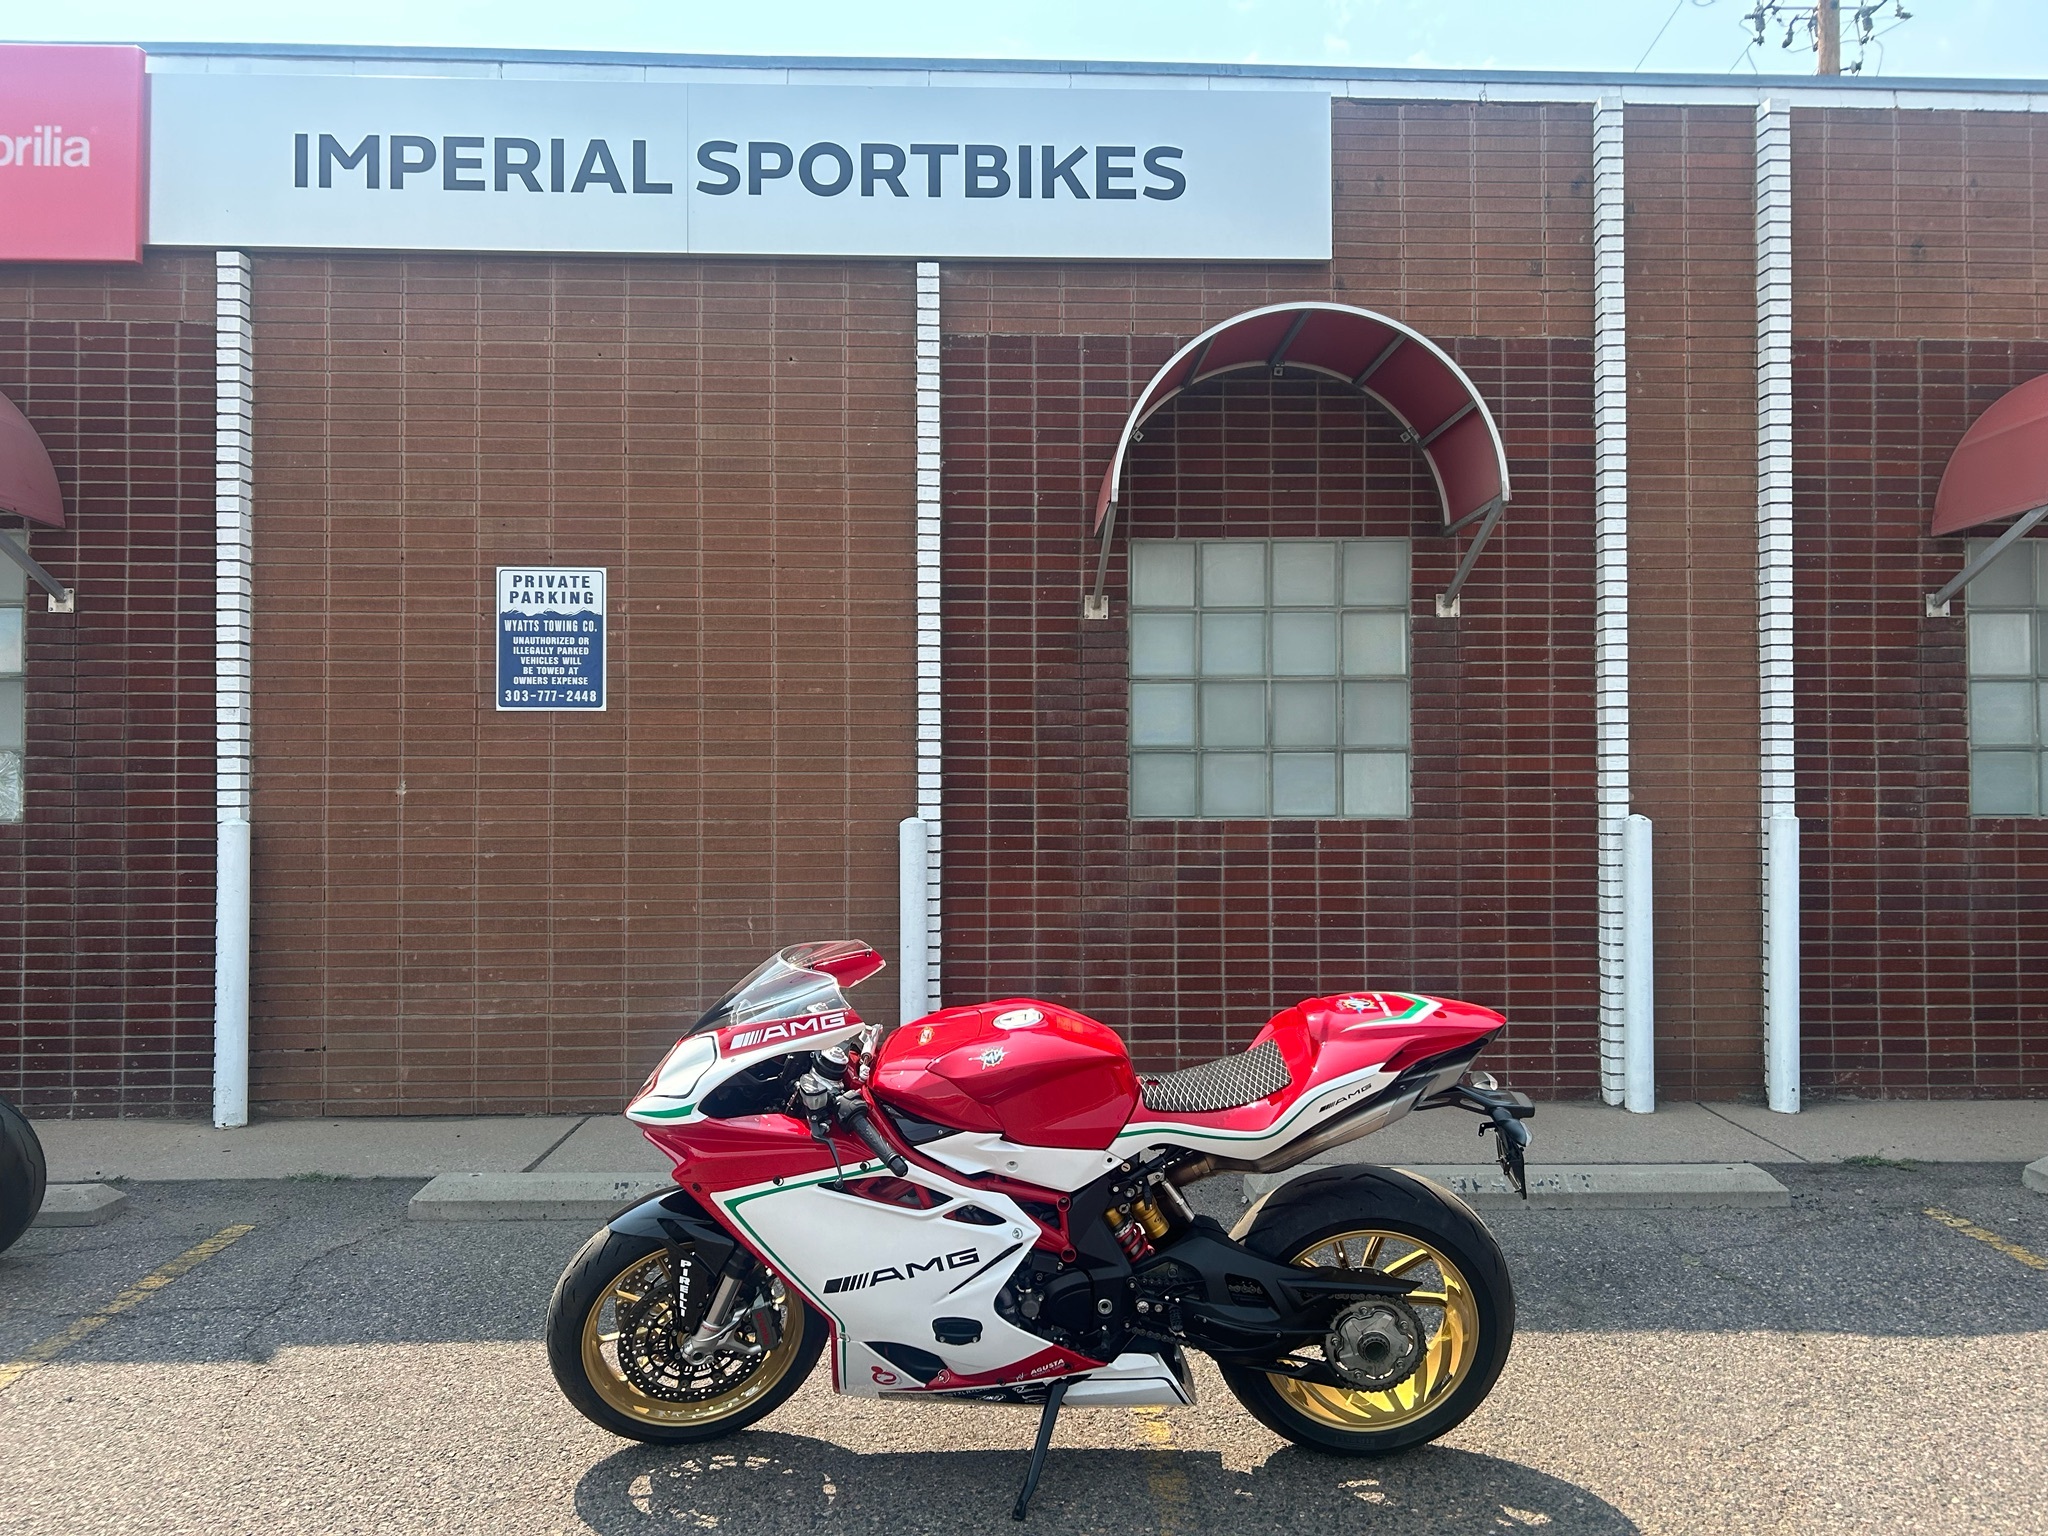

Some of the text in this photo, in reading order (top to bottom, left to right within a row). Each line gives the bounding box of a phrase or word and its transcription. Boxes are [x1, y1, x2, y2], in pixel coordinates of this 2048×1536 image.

[293, 132, 1187, 201] IMPERIAL SPORTBIKES
[513, 575, 590, 588] PRIVATE
[509, 591, 594, 604] PARKING
[504, 620, 598, 632] WYATTS TOWING CO.
[513, 636, 590, 645] UNAUTHORIZED OR
[513, 647, 589, 655] ILLEGALLY PARKED
[521, 657, 581, 665] VEHICLES WILL
[523, 667, 578, 675] BE TOWED AT
[513, 677, 588, 685] OWNERS EXPENSE
[505, 690, 597, 702] 303-777-2448
[762, 1012, 846, 1042] AMG
[1335, 1082, 1372, 1106] AMG
[869, 1247, 980, 1287] AMG
[679, 1259, 692, 1318] PIRELLI
